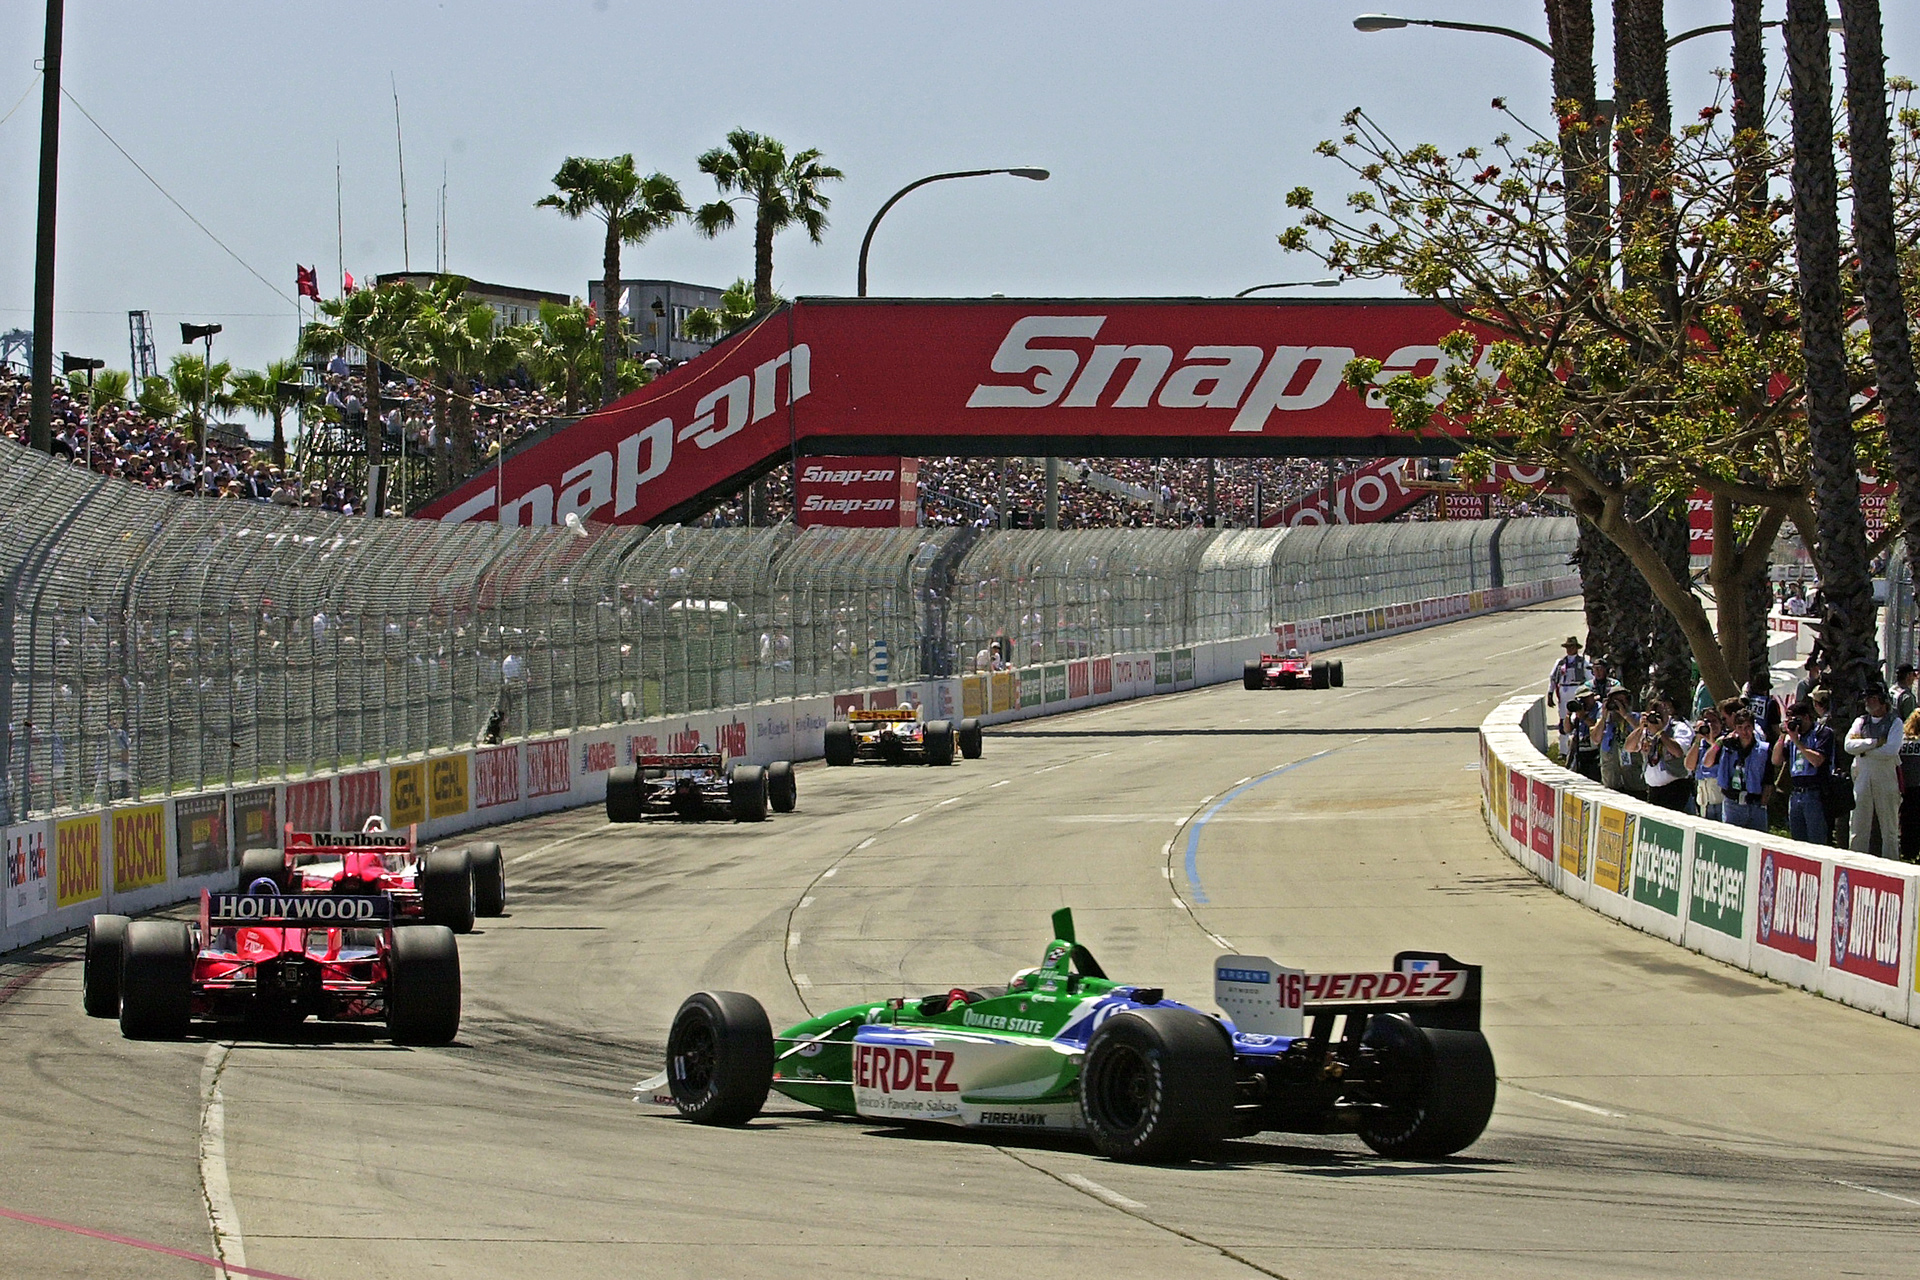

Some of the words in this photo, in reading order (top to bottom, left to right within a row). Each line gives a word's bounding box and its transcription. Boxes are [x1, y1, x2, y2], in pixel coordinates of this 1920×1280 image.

[801, 466, 895, 486] Snap-on
[801, 495, 895, 515] Snap-on
[856, 711, 912, 720] Shell
[116, 812, 163, 884] BOSCH
[315, 832, 406, 847] Marlboro
[59, 822, 99, 899] BOSCH
[219, 896, 374, 919] HOLLYWOOD
[1773, 866, 1797, 936] AUTO
[1796, 871, 1819, 941] CLUB
[1848, 885, 1876, 959] AUTO
[1875, 890, 1901, 965] CLUB
[1220, 969, 1268, 982] ARGENT
[1303, 972, 1457, 1001] HERDEZ
[1277, 973, 1301, 1009] 16
[963, 1008, 1008, 1031] QUAKER
[1007, 1017, 1045, 1034] STATE
[926, 1100, 959, 1113] Salsas
[980, 1111, 1046, 1126] FIREHAWK
